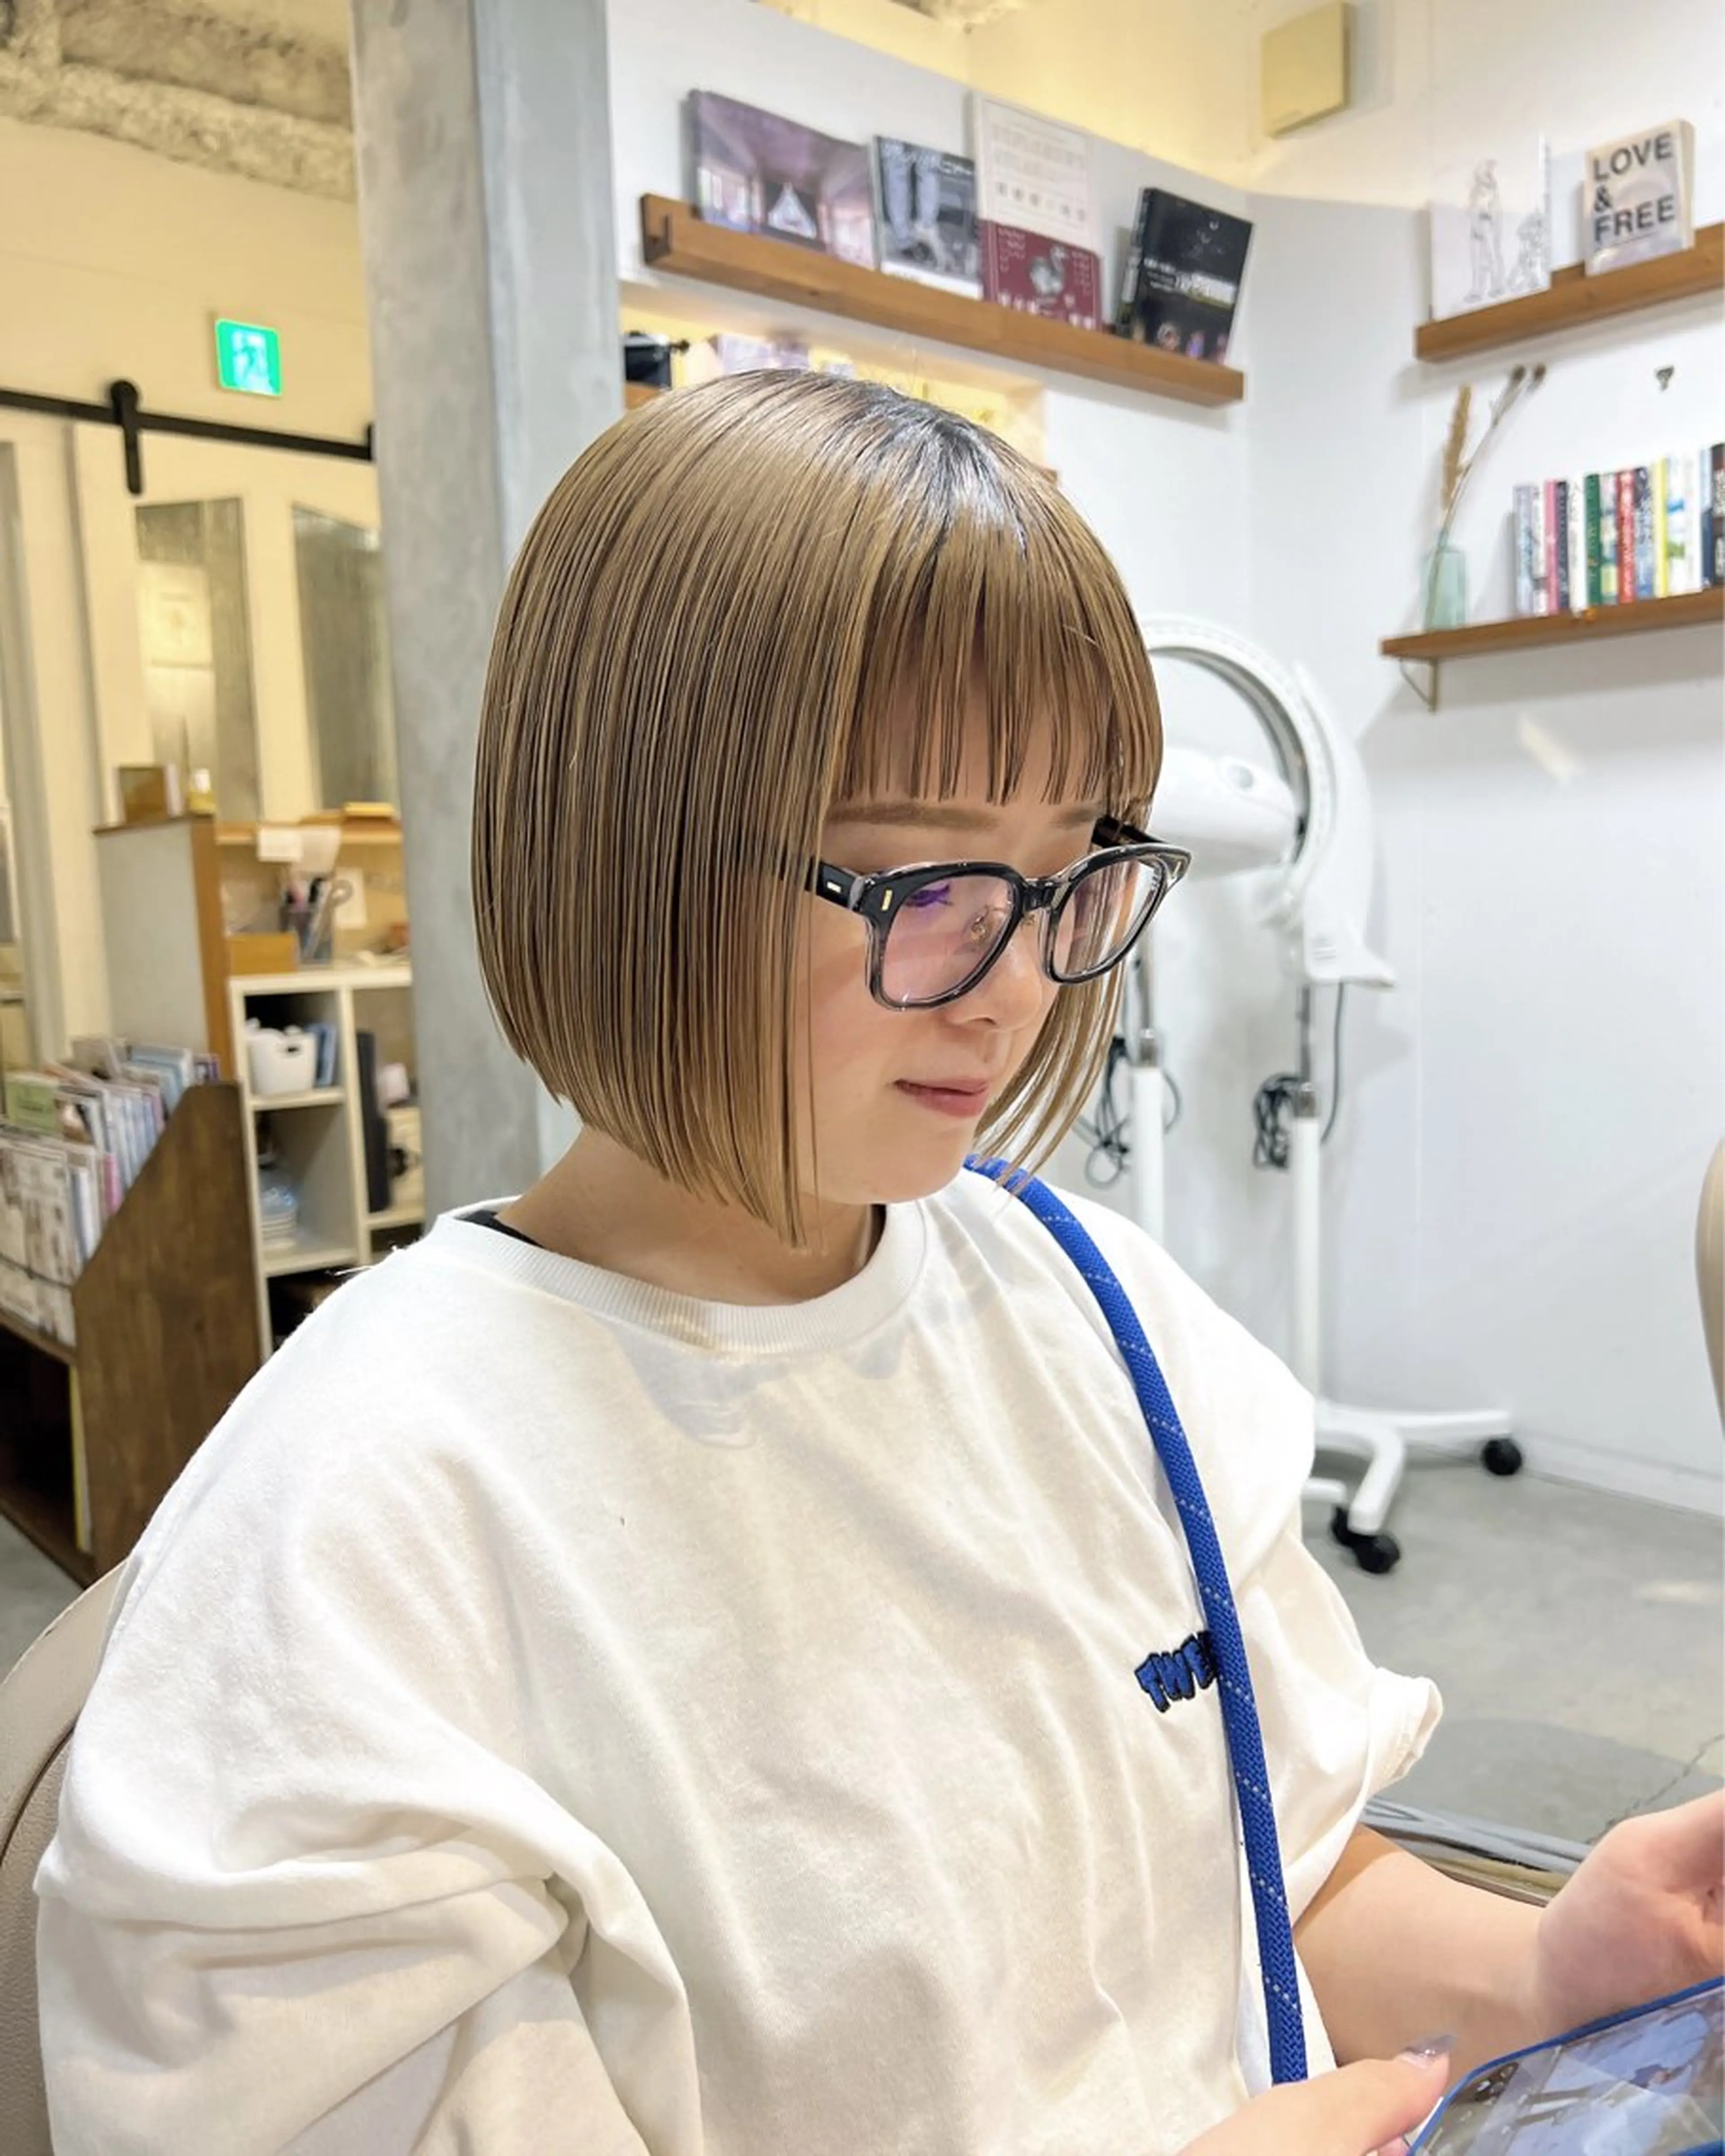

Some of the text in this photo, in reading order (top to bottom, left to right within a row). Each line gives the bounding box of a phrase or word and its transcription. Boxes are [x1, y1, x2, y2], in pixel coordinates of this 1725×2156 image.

[1594, 133, 1673, 181] LOVE
[1594, 185, 1613, 213] &
[1594, 196, 1675, 242] FREE
